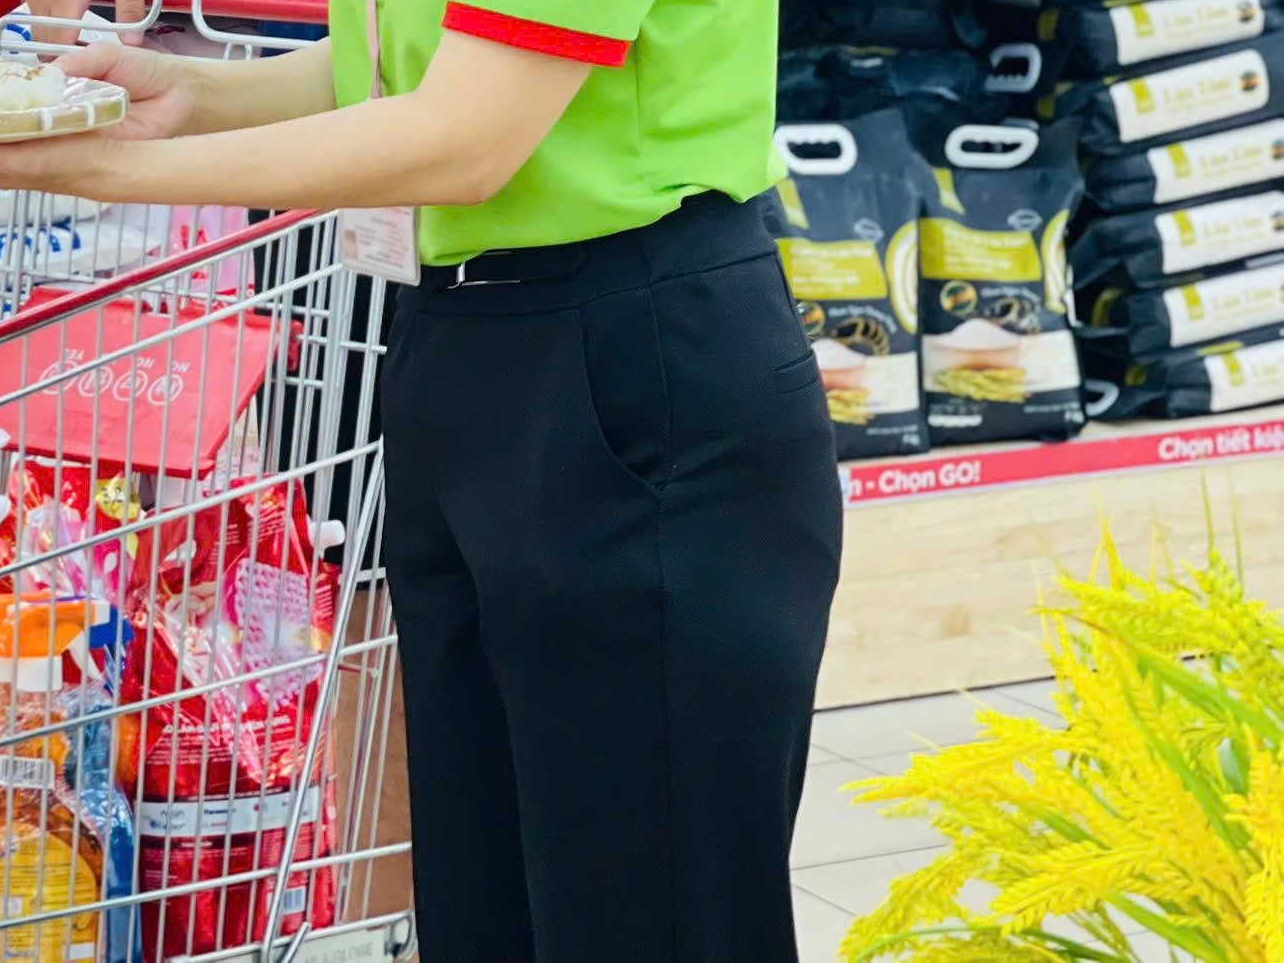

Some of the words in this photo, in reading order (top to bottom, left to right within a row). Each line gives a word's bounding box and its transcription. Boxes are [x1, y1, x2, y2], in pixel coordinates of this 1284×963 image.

[1159, 436, 1213, 461] Chọn
[1217, 428, 1251, 454] tiết
[878, 469, 936, 494] Chọn
[939, 460, 982, 486] GO!
